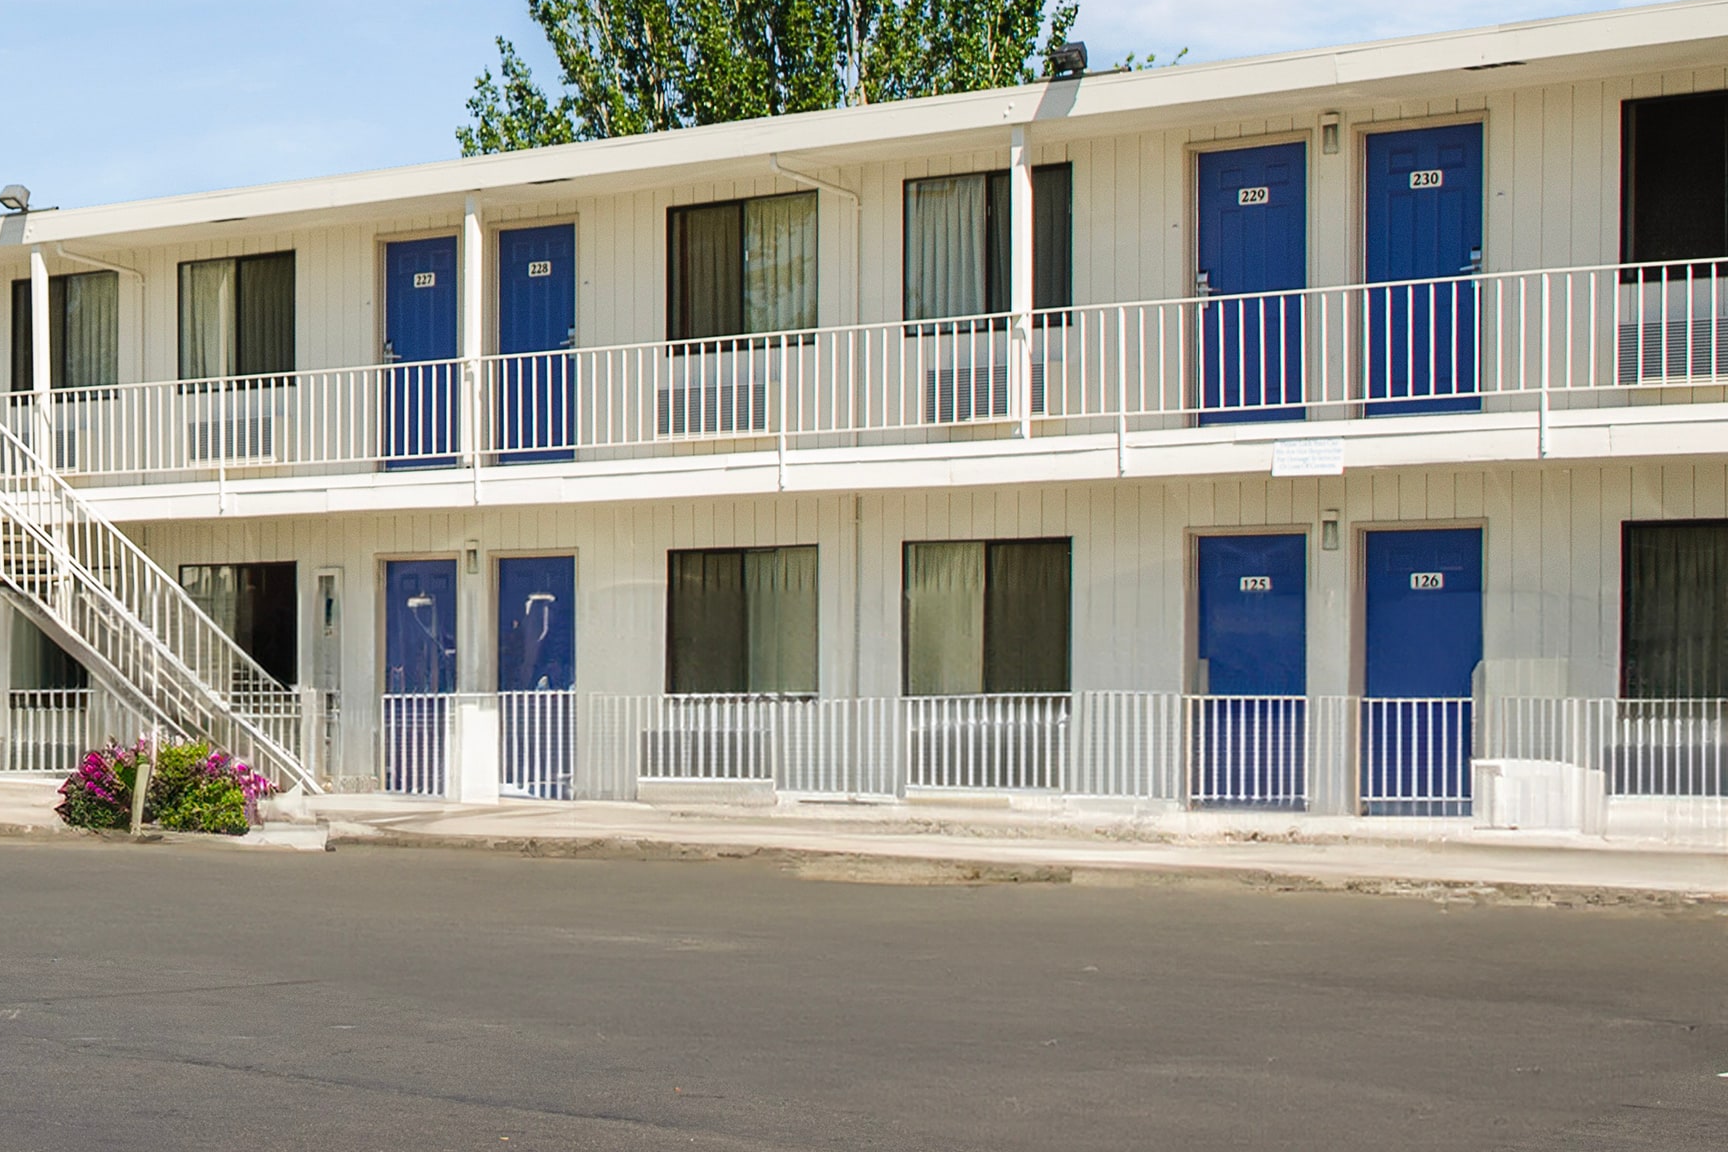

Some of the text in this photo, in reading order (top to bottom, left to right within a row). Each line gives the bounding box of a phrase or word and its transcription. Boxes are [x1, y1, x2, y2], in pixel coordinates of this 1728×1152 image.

[1412, 172, 1439, 187] 230
[1241, 188, 1265, 203] 229
[530, 263, 549, 275] 228
[415, 274, 433, 286] 227
[1243, 578, 1267, 592] 125
[1414, 574, 1439, 588] 126
